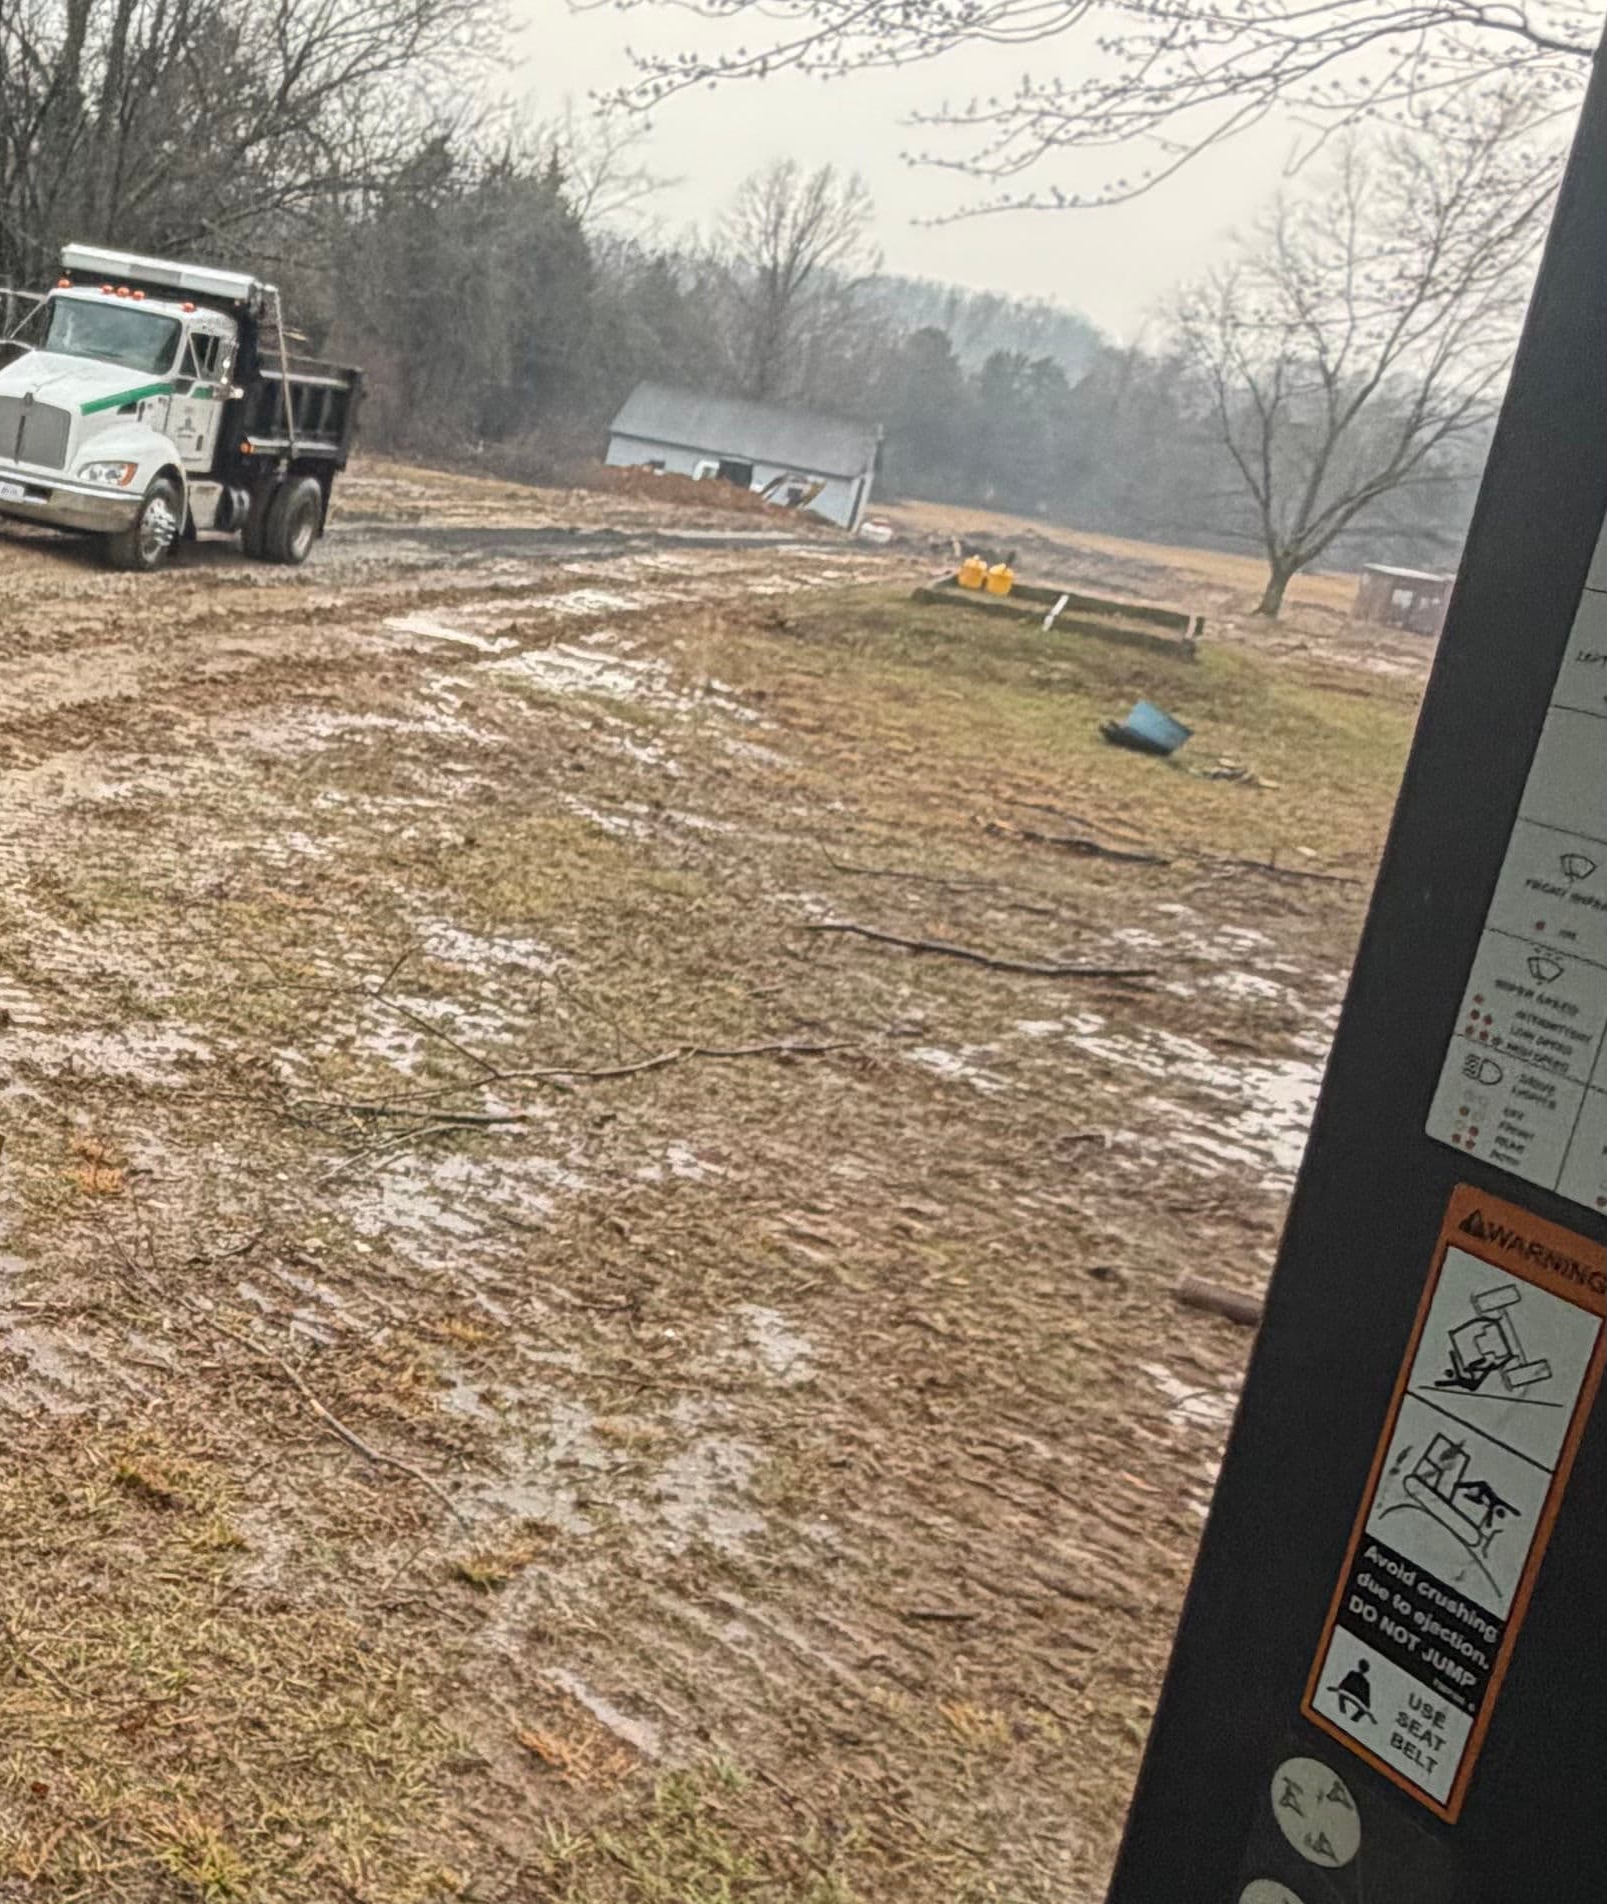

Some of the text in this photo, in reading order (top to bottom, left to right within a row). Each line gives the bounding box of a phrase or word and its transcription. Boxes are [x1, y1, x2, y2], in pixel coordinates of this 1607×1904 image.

[1488, 1221, 1606, 1295] WARNING
[1357, 1572, 1489, 1670] due to ejection.
[1364, 1545, 1498, 1643] Avoid crushing
[1349, 1595, 1477, 1687] DO NOT JUMP
[1395, 1710, 1447, 1751] SEAT
[1408, 1692, 1447, 1730] USE
[1390, 1732, 1438, 1774] BELT
